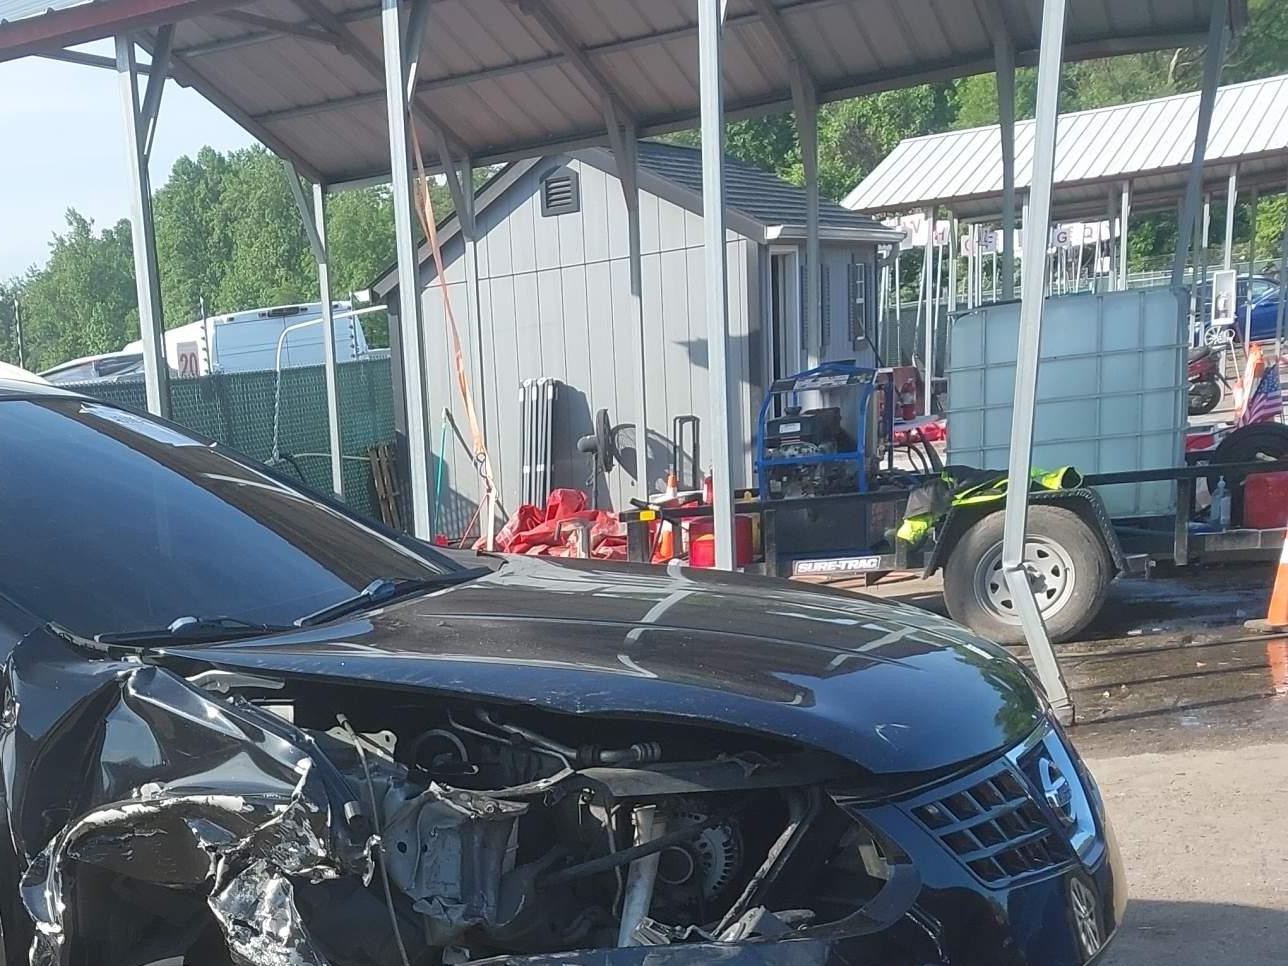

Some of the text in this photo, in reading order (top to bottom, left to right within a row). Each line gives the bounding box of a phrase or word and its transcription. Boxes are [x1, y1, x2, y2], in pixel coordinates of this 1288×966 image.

[1056, 231, 1068, 243] G
[179, 352, 199, 377] 20
[797, 558, 878, 573] SURE-TRAC
